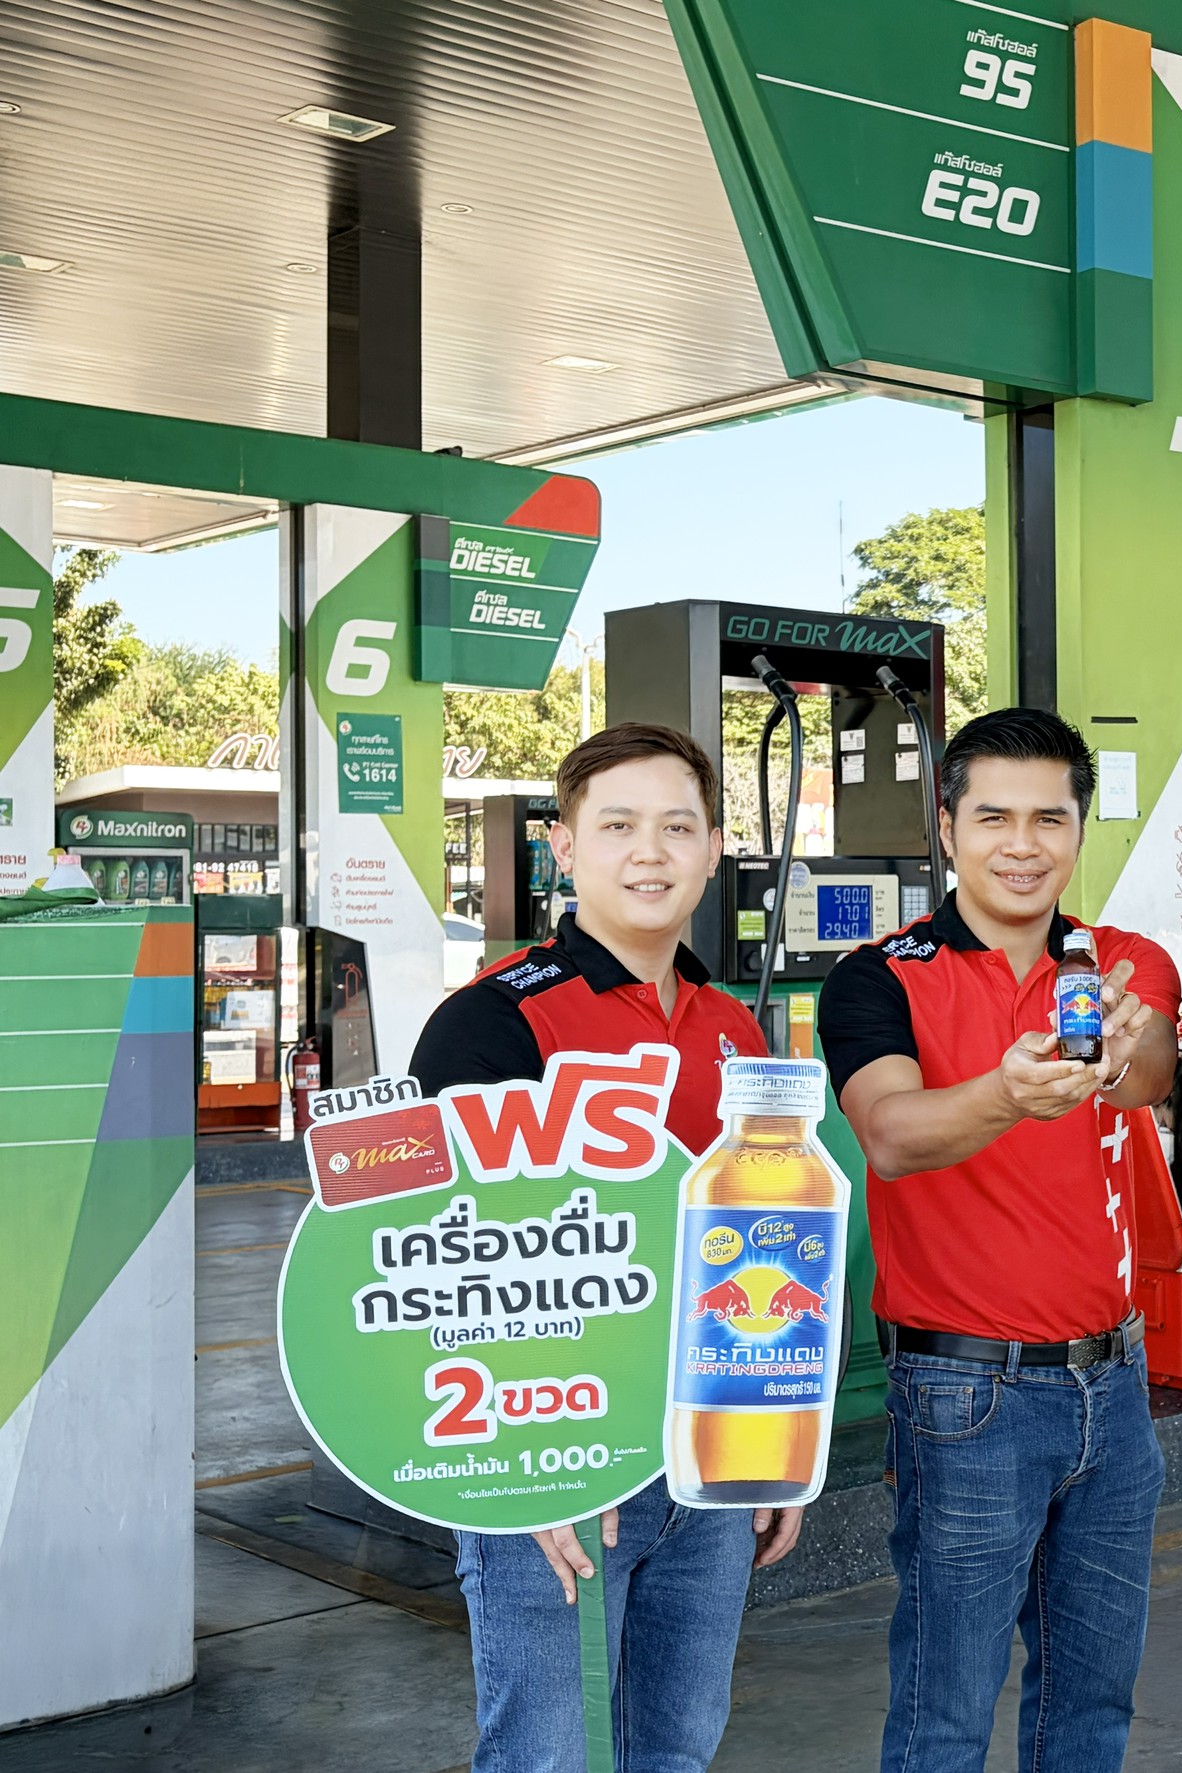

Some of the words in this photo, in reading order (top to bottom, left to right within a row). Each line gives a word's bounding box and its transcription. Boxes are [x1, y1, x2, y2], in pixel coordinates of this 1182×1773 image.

[959, 49, 1036, 110] 95
[921, 169, 1040, 237] E20
[449, 549, 536, 579] DIESEL
[474, 589, 508, 606] ดีเซล
[469, 603, 546, 630] DIESEL
[726, 616, 770, 641] GO
[774, 620, 830, 646] FOR
[326, 619, 398, 698] 6
[363, 769, 397, 782] 1614
[97, 819, 187, 838] Maxnitron
[345, 857, 386, 869] อันตราย
[496, 962, 540, 983] SERVICE
[511, 964, 562, 990] CHAMPION
[313, 1078, 418, 1117] สมาชิก
[452, 1053, 671, 1172] ฟรี
[411, 1149, 436, 1159] CARD
[425, 1166, 445, 1175] PLUS
[381, 1195, 629, 1268] เครื่องดื่ม
[361, 1272, 649, 1325] กระทิงแดง
[433, 1321, 495, 1349] (มูลค่า
[504, 1321, 526, 1338] 12
[535, 1316, 582, 1338] บาท)
[687, 1342, 824, 1362] กระทิงแดง
[686, 1362, 824, 1377] KRATINGDAENG
[434, 1367, 488, 1437] 2
[502, 1382, 600, 1418] ขวด
[393, 1453, 510, 1483] เมื่อเติมน้ำมัน
